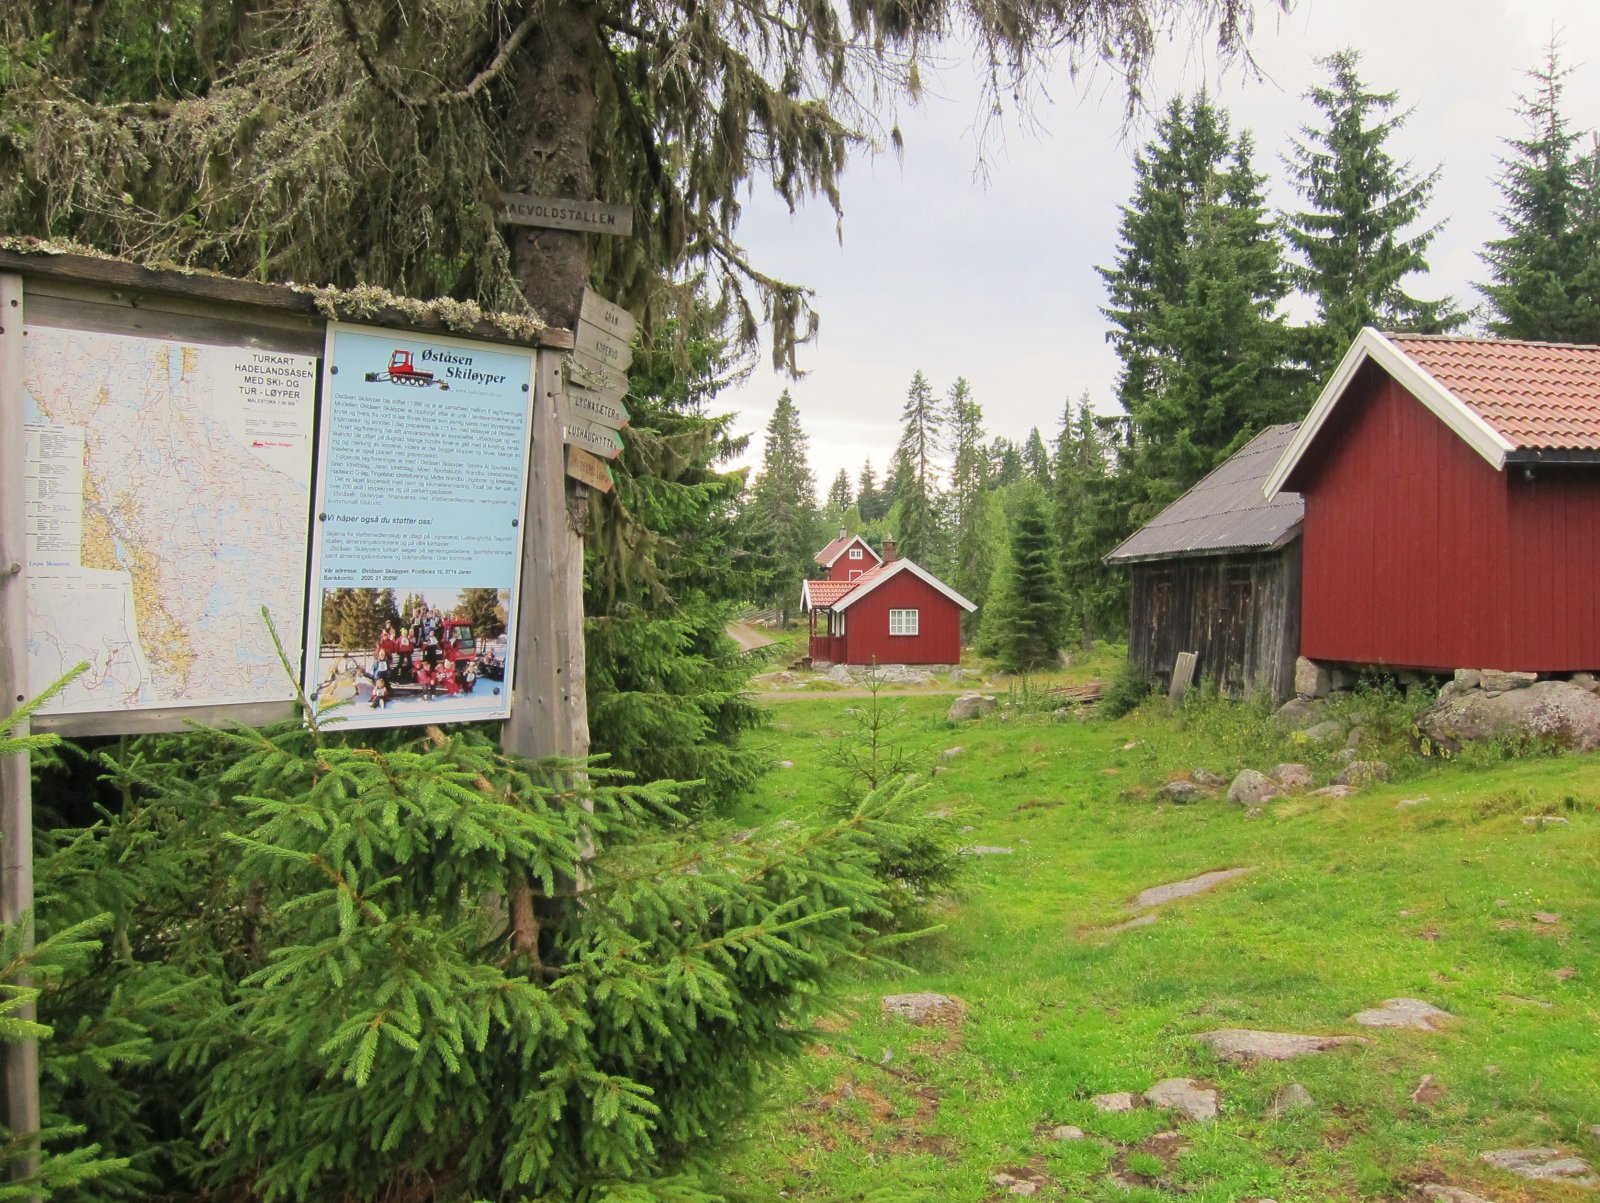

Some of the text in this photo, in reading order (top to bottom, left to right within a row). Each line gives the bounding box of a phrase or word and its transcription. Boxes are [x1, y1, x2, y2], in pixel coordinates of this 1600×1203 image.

[253, 354, 294, 365] TURKART
[421, 348, 473, 366] Øståsen
[244, 376, 299, 388] MED SKI- OG
[446, 366, 506, 386] Skiløyper
[239, 386, 257, 395] TUR
[265, 389, 300, 398] LØYPER
[575, 395, 615, 420] LYGNASÆTER
[336, 515, 359, 524] håper
[360, 516, 379, 525] også
